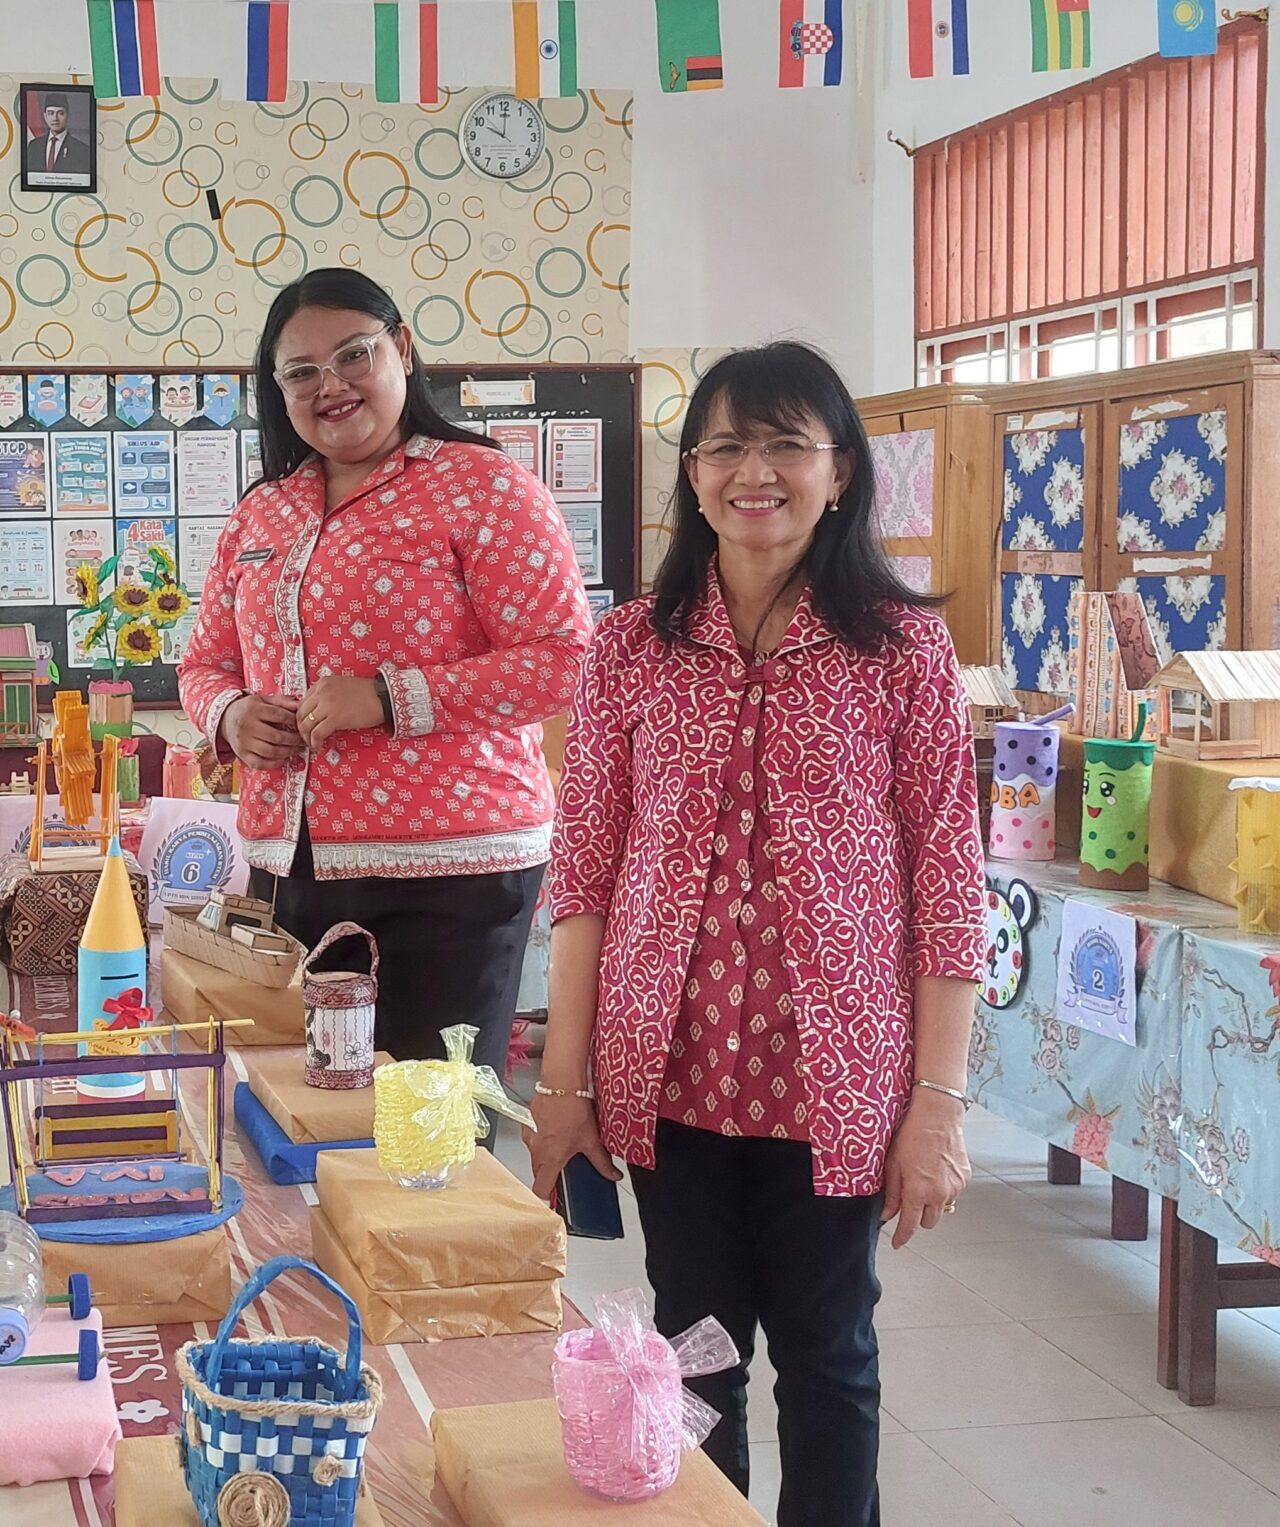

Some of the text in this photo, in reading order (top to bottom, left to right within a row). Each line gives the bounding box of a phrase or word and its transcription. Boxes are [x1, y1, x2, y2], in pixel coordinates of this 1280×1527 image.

[486, 105, 495, 115] 11
[499, 101, 510, 111] 12
[518, 106, 522, 117] 1
[474, 116, 485, 127] 10
[526, 117, 533, 128] 2
[469, 130, 477, 141] 9
[530, 132, 537, 142] 3
[474, 146, 481, 157] 8
[525, 147, 531, 158] 4
[484, 157, 491, 167] 7
[499, 161, 506, 172] 6
[514, 157, 521, 168] 5
[128, 519, 163, 542] 4 Kata
[140, 530, 165, 541] Sakti
[182, 862, 201, 884] 6
[1092, 969, 1105, 991] 2
[102, 1325, 168, 1384] MES
